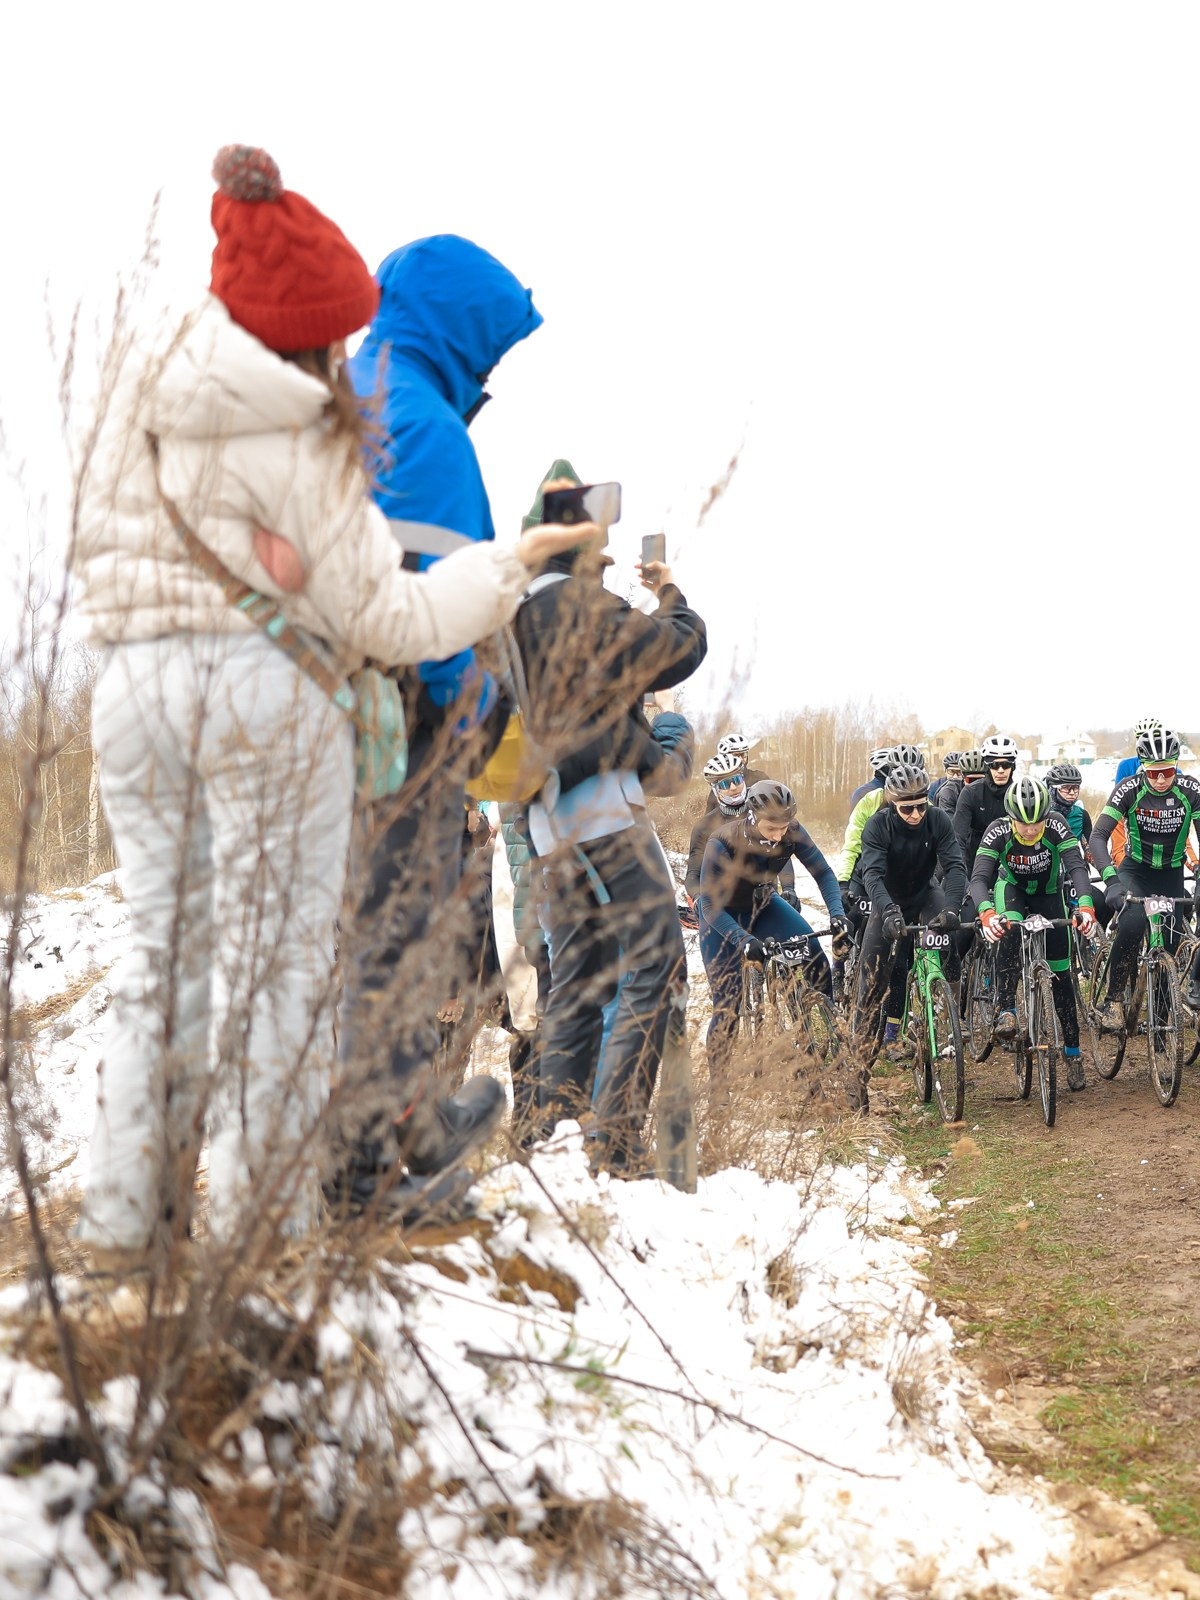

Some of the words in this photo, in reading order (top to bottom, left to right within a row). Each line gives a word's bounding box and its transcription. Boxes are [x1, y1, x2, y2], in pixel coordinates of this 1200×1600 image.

[1137, 815, 1160, 825] OLYMPIC
[1161, 816, 1183, 825] SCHOOL
[1045, 818, 1069, 839] USSIA
[1150, 899, 1174, 912] 068
[926, 934, 950, 946] 008
